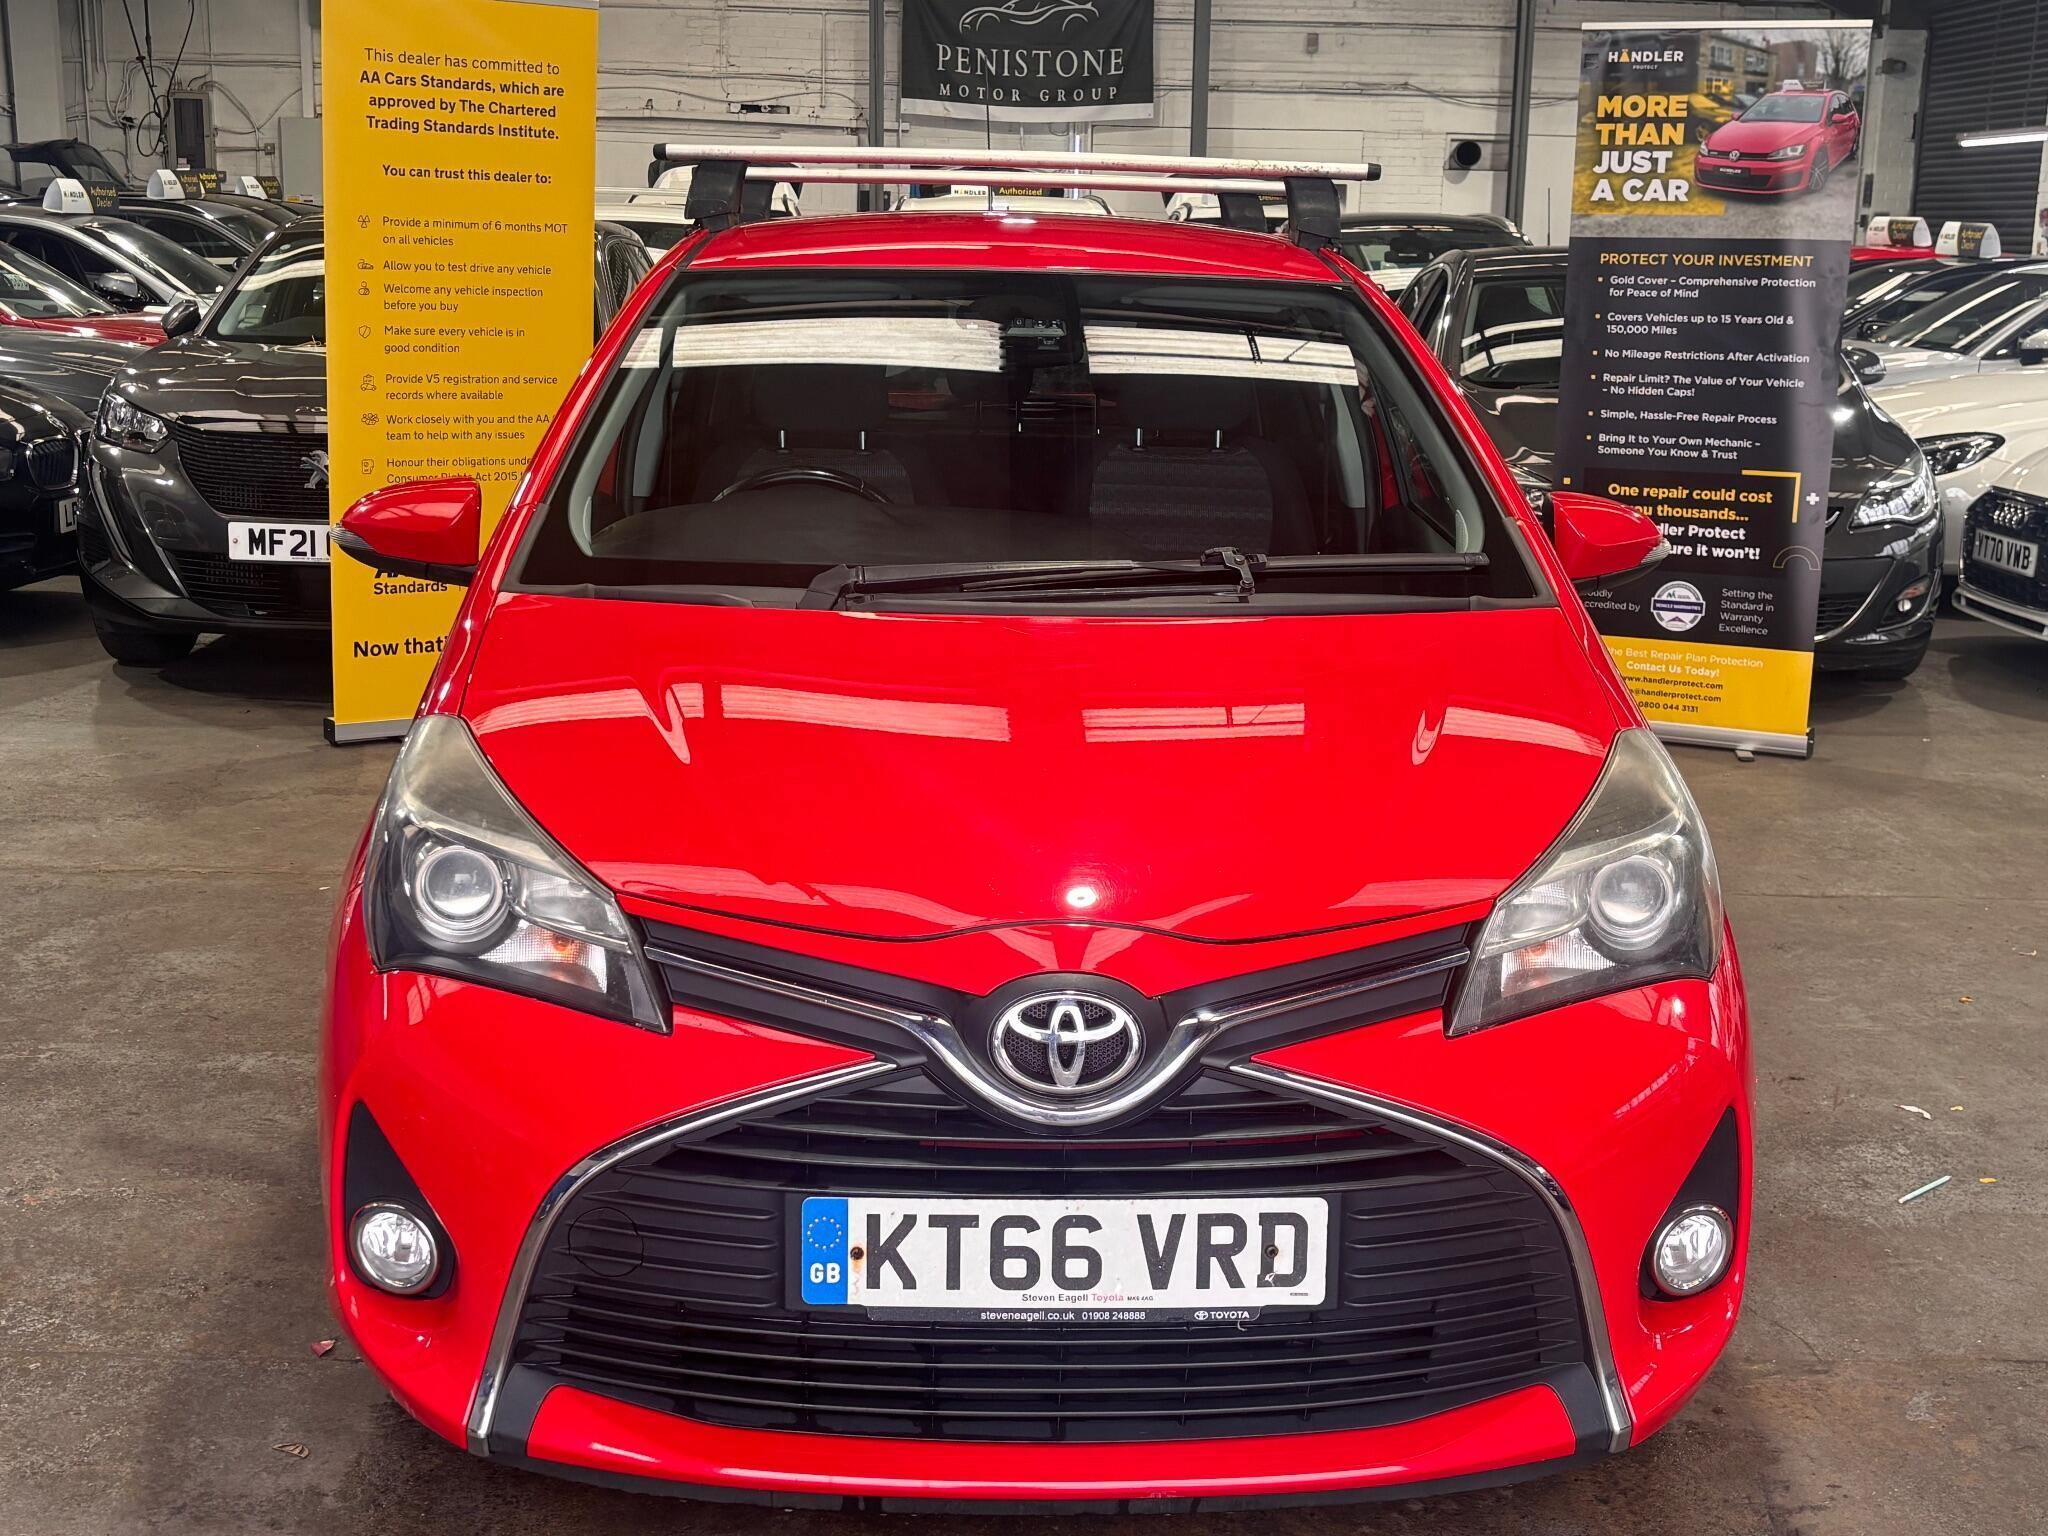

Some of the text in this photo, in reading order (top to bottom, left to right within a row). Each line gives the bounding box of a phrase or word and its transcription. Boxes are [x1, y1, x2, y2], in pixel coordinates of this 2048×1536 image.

[364, 47, 559, 75] This dealer has committed to
[936, 43, 1123, 77] PENISTONE
[360, 70, 564, 96] AA Cars Standards, which are
[939, 82, 1116, 101] MOTOR GROUP
[368, 96, 556, 118] approved by The Chartered
[1597, 95, 1688, 118] MORE
[365, 115, 558, 139] Trading Standards Institute.
[1596, 123, 1685, 146] THAN
[1593, 151, 1673, 174] JUST
[382, 164, 551, 184] You can trust this dealer to:
[1590, 178, 1689, 202] A CAR
[382, 215, 567, 234] Provide minimum months MOT
[412, 235, 453, 245] vehicles
[383, 259, 551, 274] Allow test drive vehicle
[1600, 252, 1814, 267] PROTECT YOUR INVESTMENT
[1610, 275, 1816, 287] Gold Cover Comprehensive Protection
[383, 282, 543, 298] Welcome vehicle inspection
[1626, 287, 1698, 297] Peace Mind
[383, 299, 458, 312] before buy
[1607, 312, 1762, 324] Covers Vehicles 15 Years
[384, 325, 503, 338] Make sure every vehicle
[1606, 324, 1677, 334] 150,000 Miles
[384, 342, 459, 354] good condition
[1604, 349, 1810, 363] No Mileage Restrictions After Activation
[385, 373, 557, 385] Provide V5 registration service
[1602, 373, 1806, 388] Repair Limit? Value Your Vehicle
[385, 389, 503, 400] records where available
[1610, 385, 1695, 397] No Hidden Caps!
[385, 413, 550, 426] Work closely AA
[1600, 409, 1777, 424] Simple, Hassle-Free Repair Process
[386, 430, 525, 440] team help issues
[1598, 433, 1752, 448] Bring Your Own Mechanic
[1597, 445, 1737, 459] Someone You Know Trust
[386, 456, 505, 467] Honour their obligations
[1608, 483, 1772, 503] One repair could cost
[1656, 504, 1748, 521] thousands...
[1688, 524, 1746, 540] Protect
[248, 528, 316, 557] MF21
[1696, 543, 1760, 559] it won't!
[374, 581, 448, 595] Standards
[1722, 588, 1773, 600] Setting the
[1720, 599, 1763, 611] Standard
[1720, 611, 1763, 624] Warranty
[1718, 623, 1768, 635] Excellence
[353, 640, 399, 658] Now
[1626, 660, 1719, 678] Contact Today!
[1638, 700, 1698, 712] 0800 044 3131
[866, 1212, 1308, 1290] KT66 VRD
[810, 1262, 840, 1283] GB
[1021, 1293, 1055, 1301] Steven
[1058, 1293, 1088, 1303] Eagell
[1091, 1293, 1124, 1303] Toyota
[980, 1310, 1145, 1322] steveneagell.co.uk 01908 248888
[1209, 1310, 1249, 1319] TOYOTA
